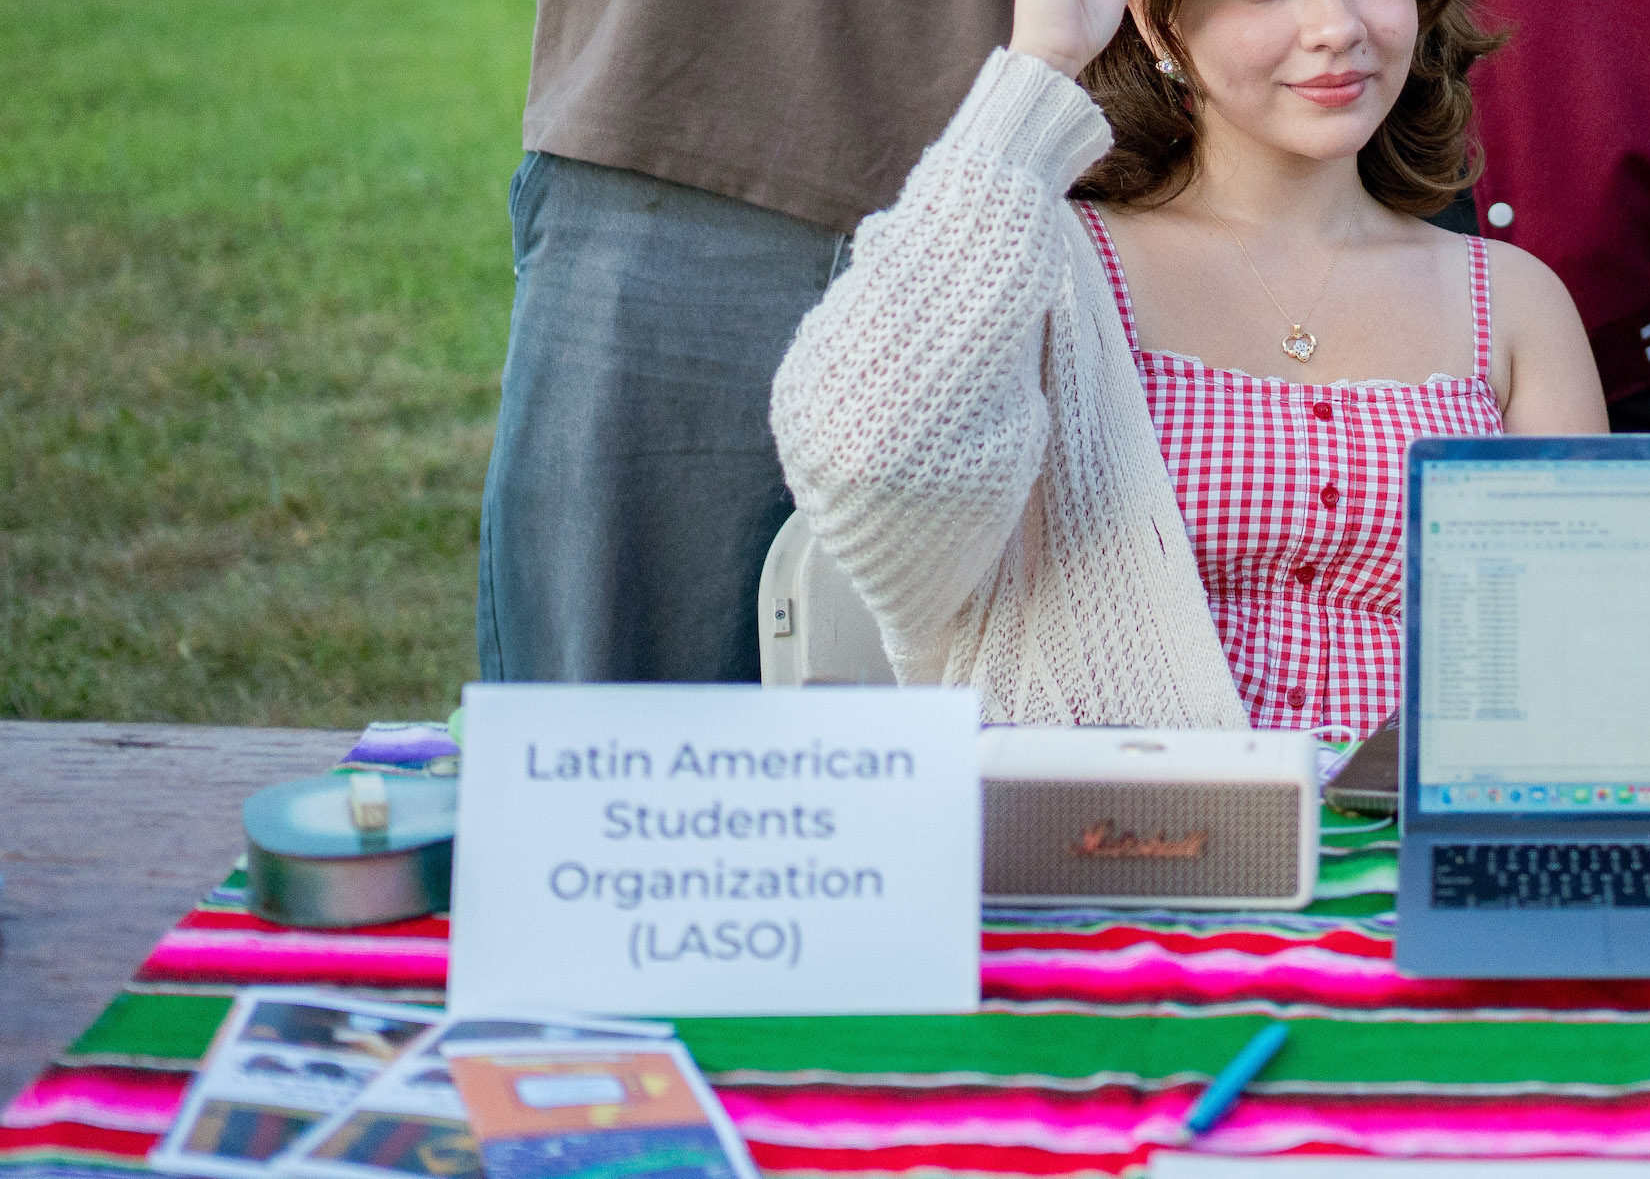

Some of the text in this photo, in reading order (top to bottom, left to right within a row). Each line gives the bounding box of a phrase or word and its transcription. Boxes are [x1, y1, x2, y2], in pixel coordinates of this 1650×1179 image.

[526, 739, 915, 780] Latin American
[603, 800, 835, 840] Students
[549, 858, 884, 910] Organization
[629, 920, 801, 969] (LASO)
